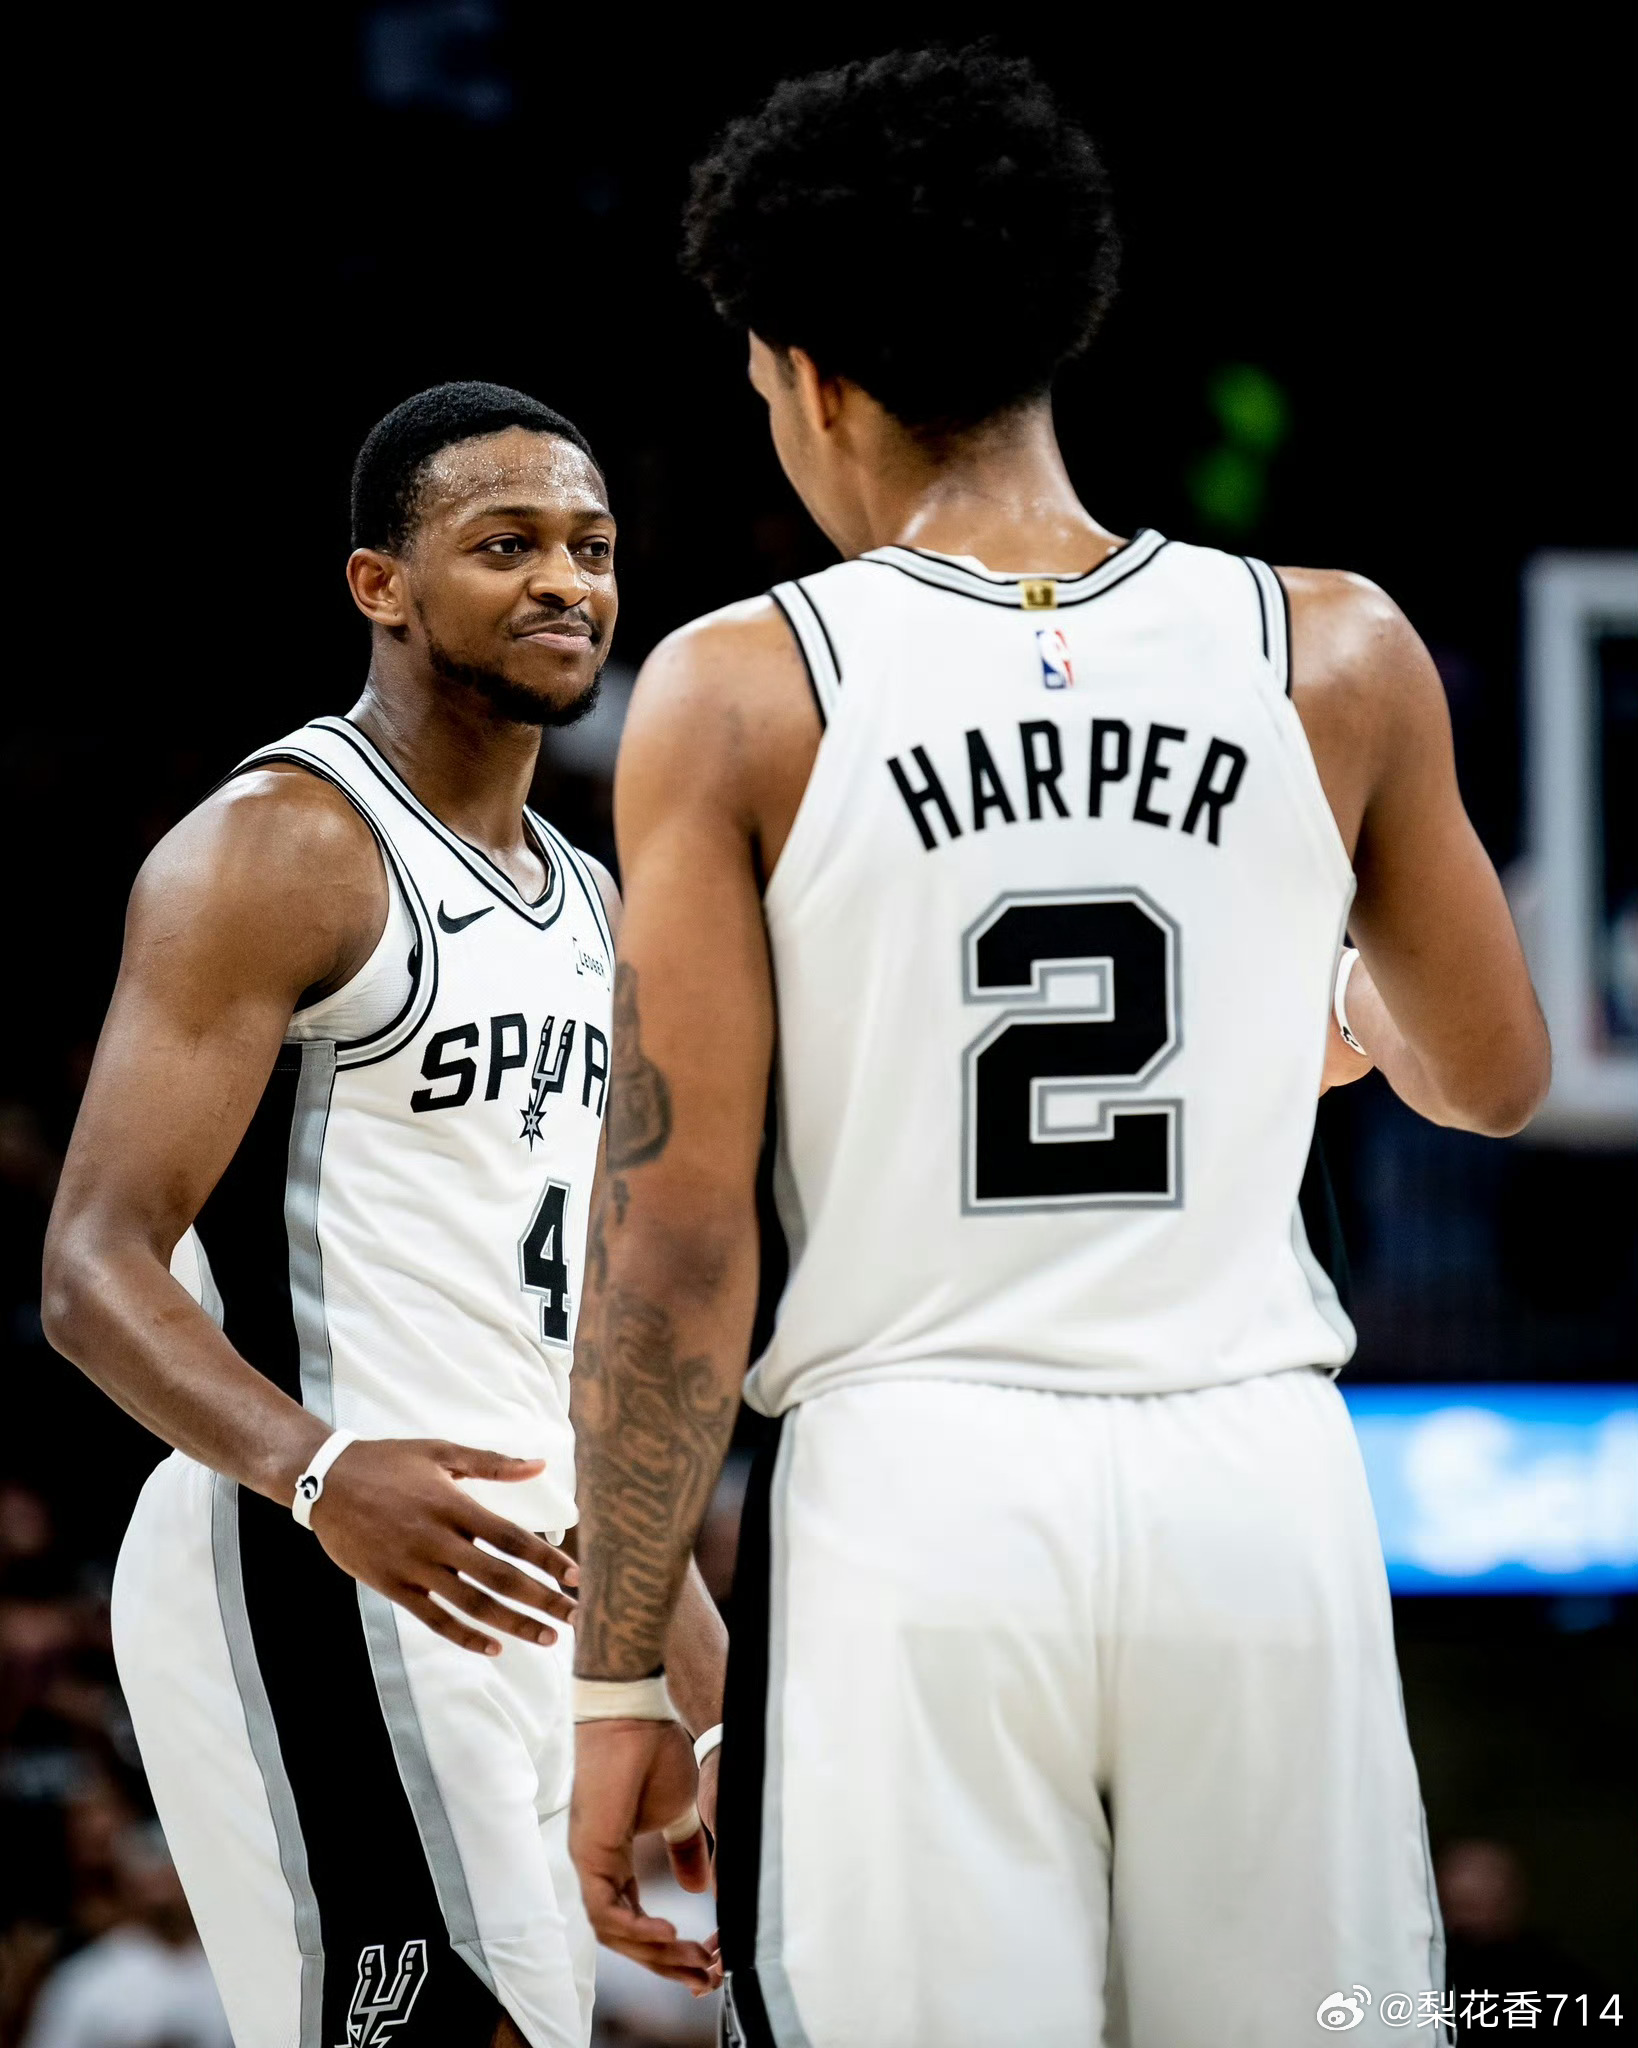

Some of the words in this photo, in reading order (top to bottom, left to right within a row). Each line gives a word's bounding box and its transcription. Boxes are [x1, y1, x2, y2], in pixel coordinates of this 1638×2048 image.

[887, 718, 1249, 852] HARPER
[410, 1013, 609, 1151] SPUR
[960, 886, 1185, 1217] 2
[516, 1176, 573, 1350] 4
